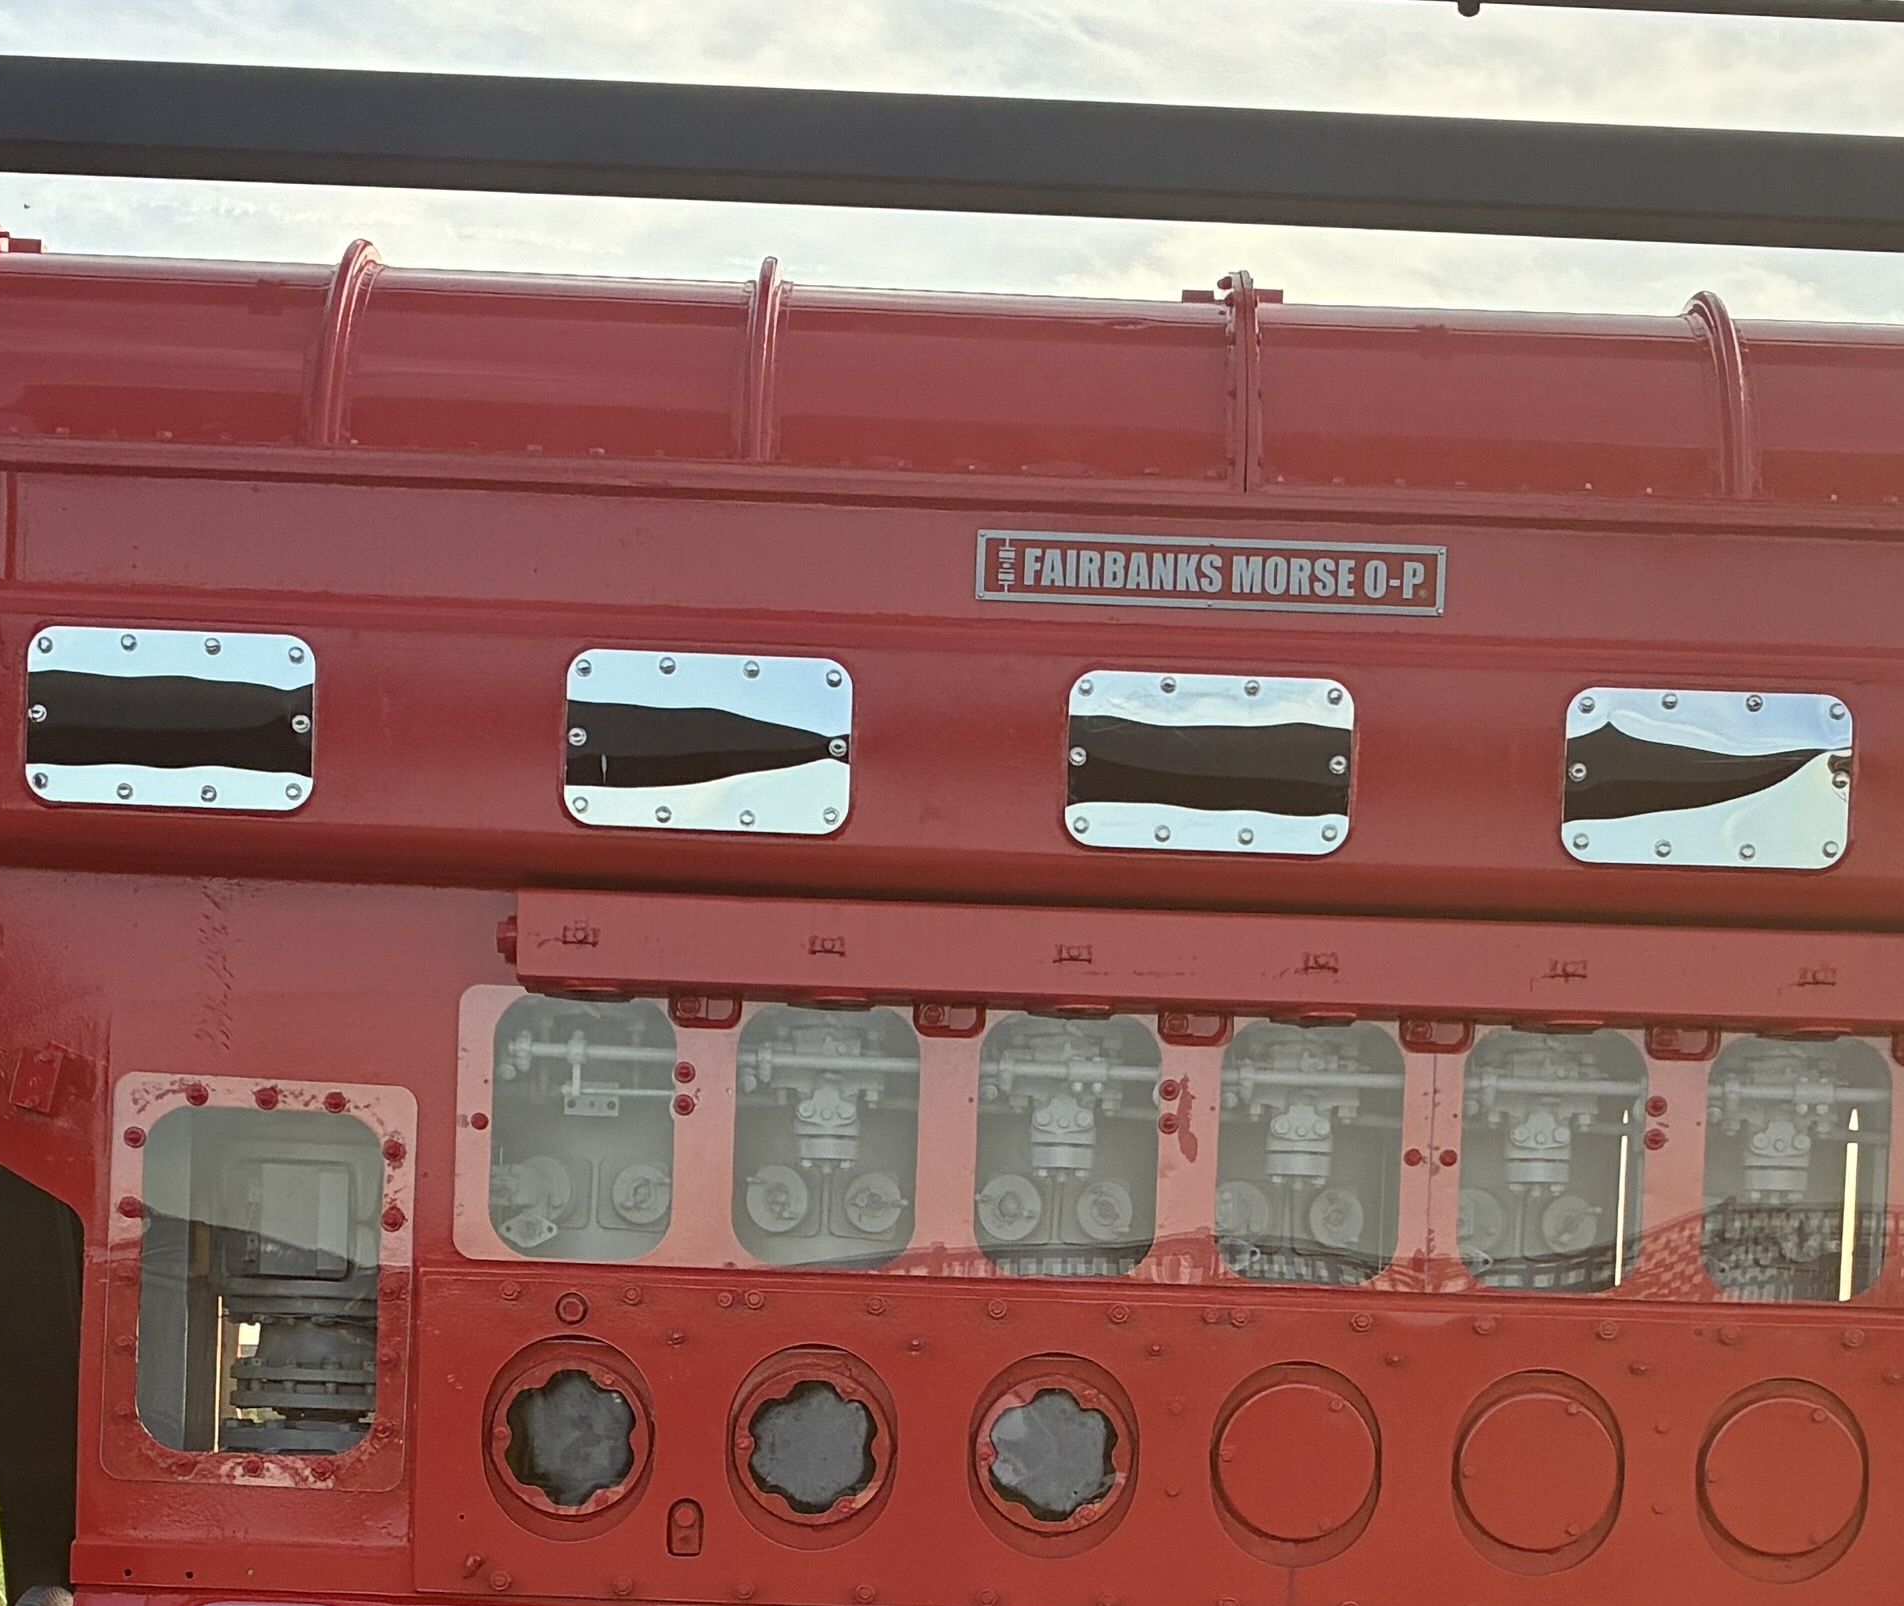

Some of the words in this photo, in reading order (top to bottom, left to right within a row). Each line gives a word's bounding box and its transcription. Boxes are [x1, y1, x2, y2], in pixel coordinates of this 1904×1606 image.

[1024, 547, 1222, 594] FAIRBANKS
[1232, 555, 1356, 598] MORSE
[1363, 559, 1425, 600] O-P
